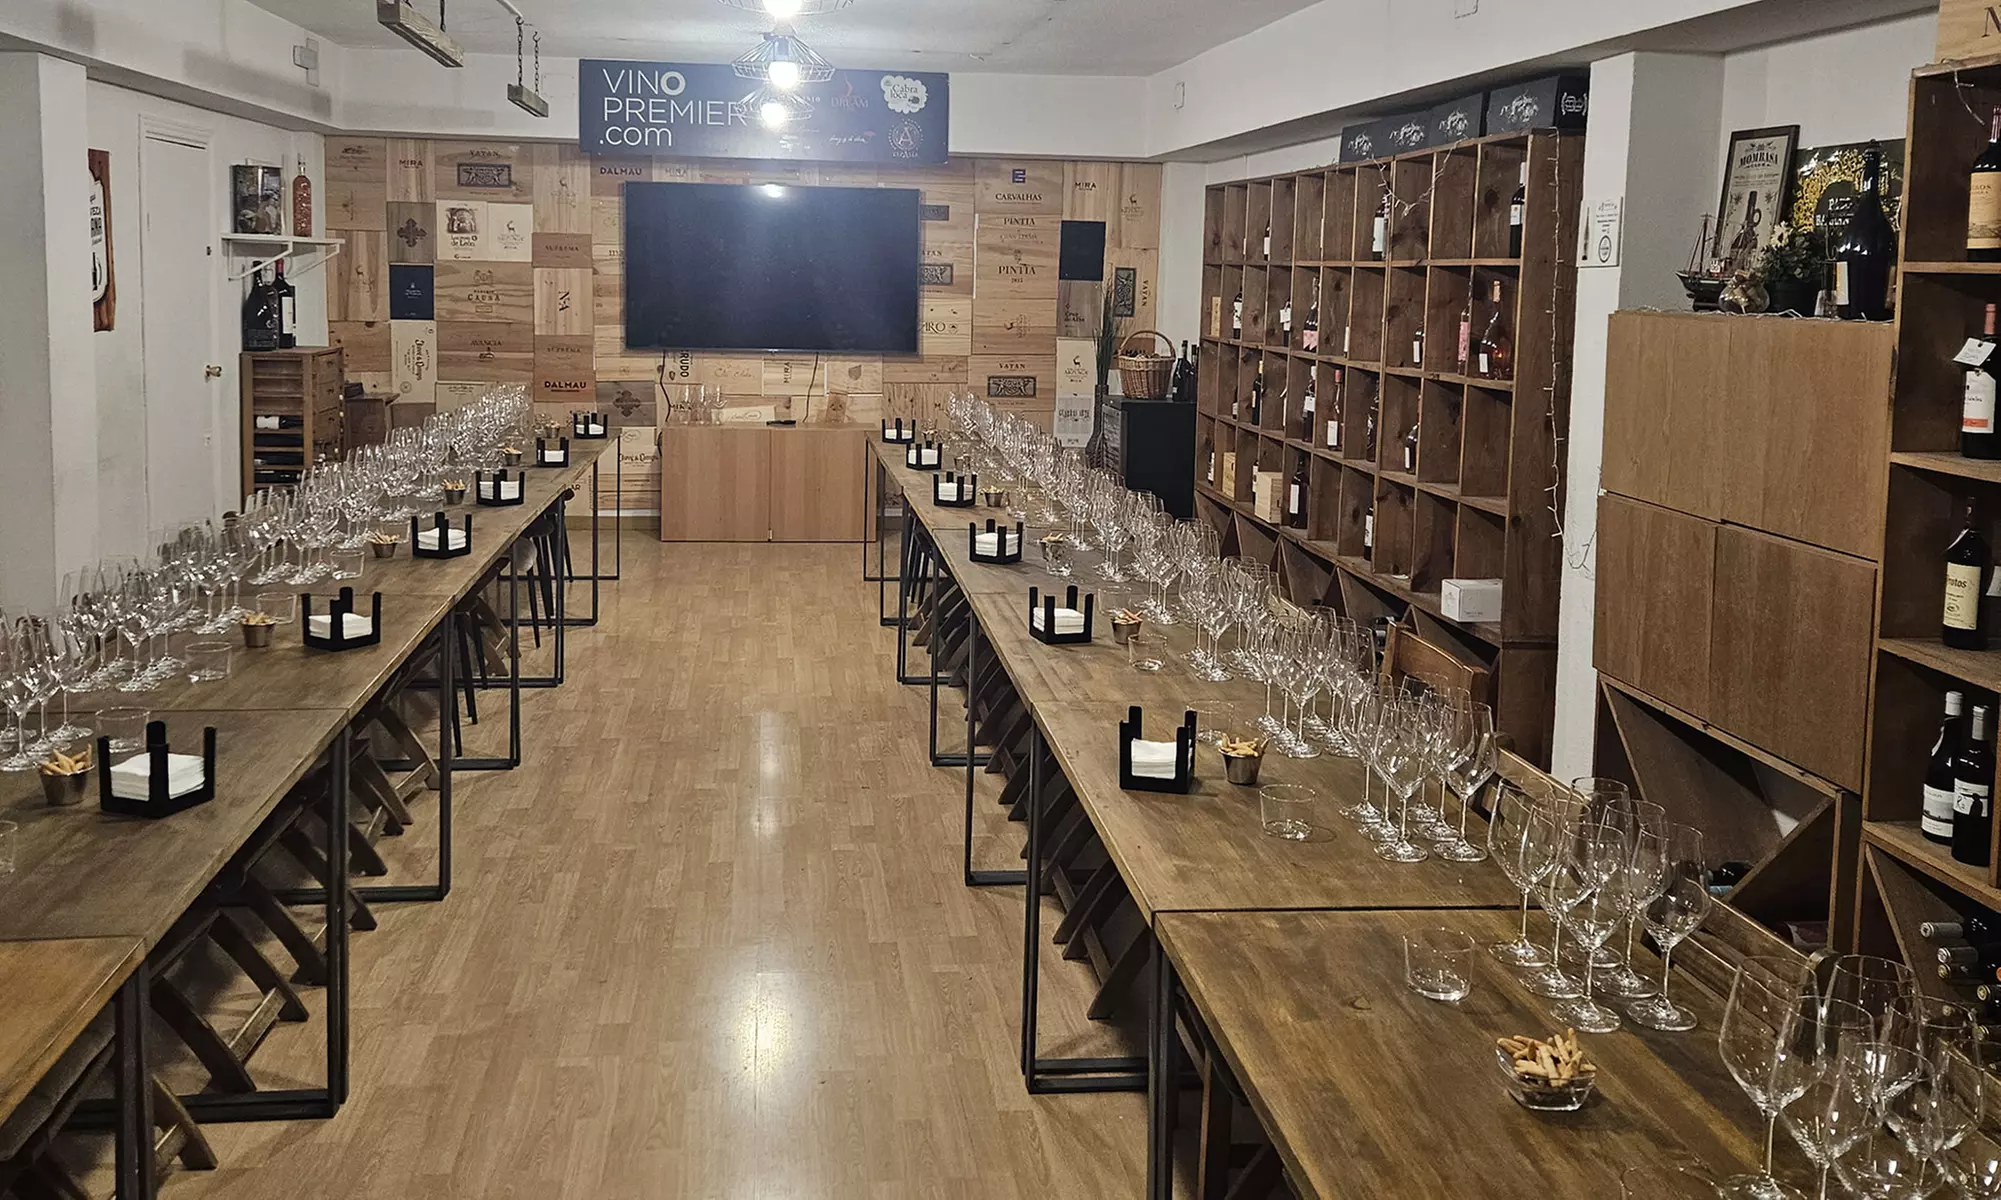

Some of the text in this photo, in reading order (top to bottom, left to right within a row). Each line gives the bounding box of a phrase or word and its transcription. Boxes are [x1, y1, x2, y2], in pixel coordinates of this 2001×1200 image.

[602, 68, 686, 96] VINO
[891, 83, 919, 95] Cabra
[603, 97, 748, 127] PREMIER
[599, 126, 672, 147] .com
[399, 159, 424, 167] MIRA
[600, 166, 642, 176] DALMAU
[1074, 181, 1097, 189] MIRA
[995, 193, 1043, 202] CARVALHAS
[1003, 217, 1036, 226] PINTIA
[998, 265, 1037, 275] PINTIA
[679, 350, 690, 378] RUDO
[544, 381, 587, 389] DALMAU
